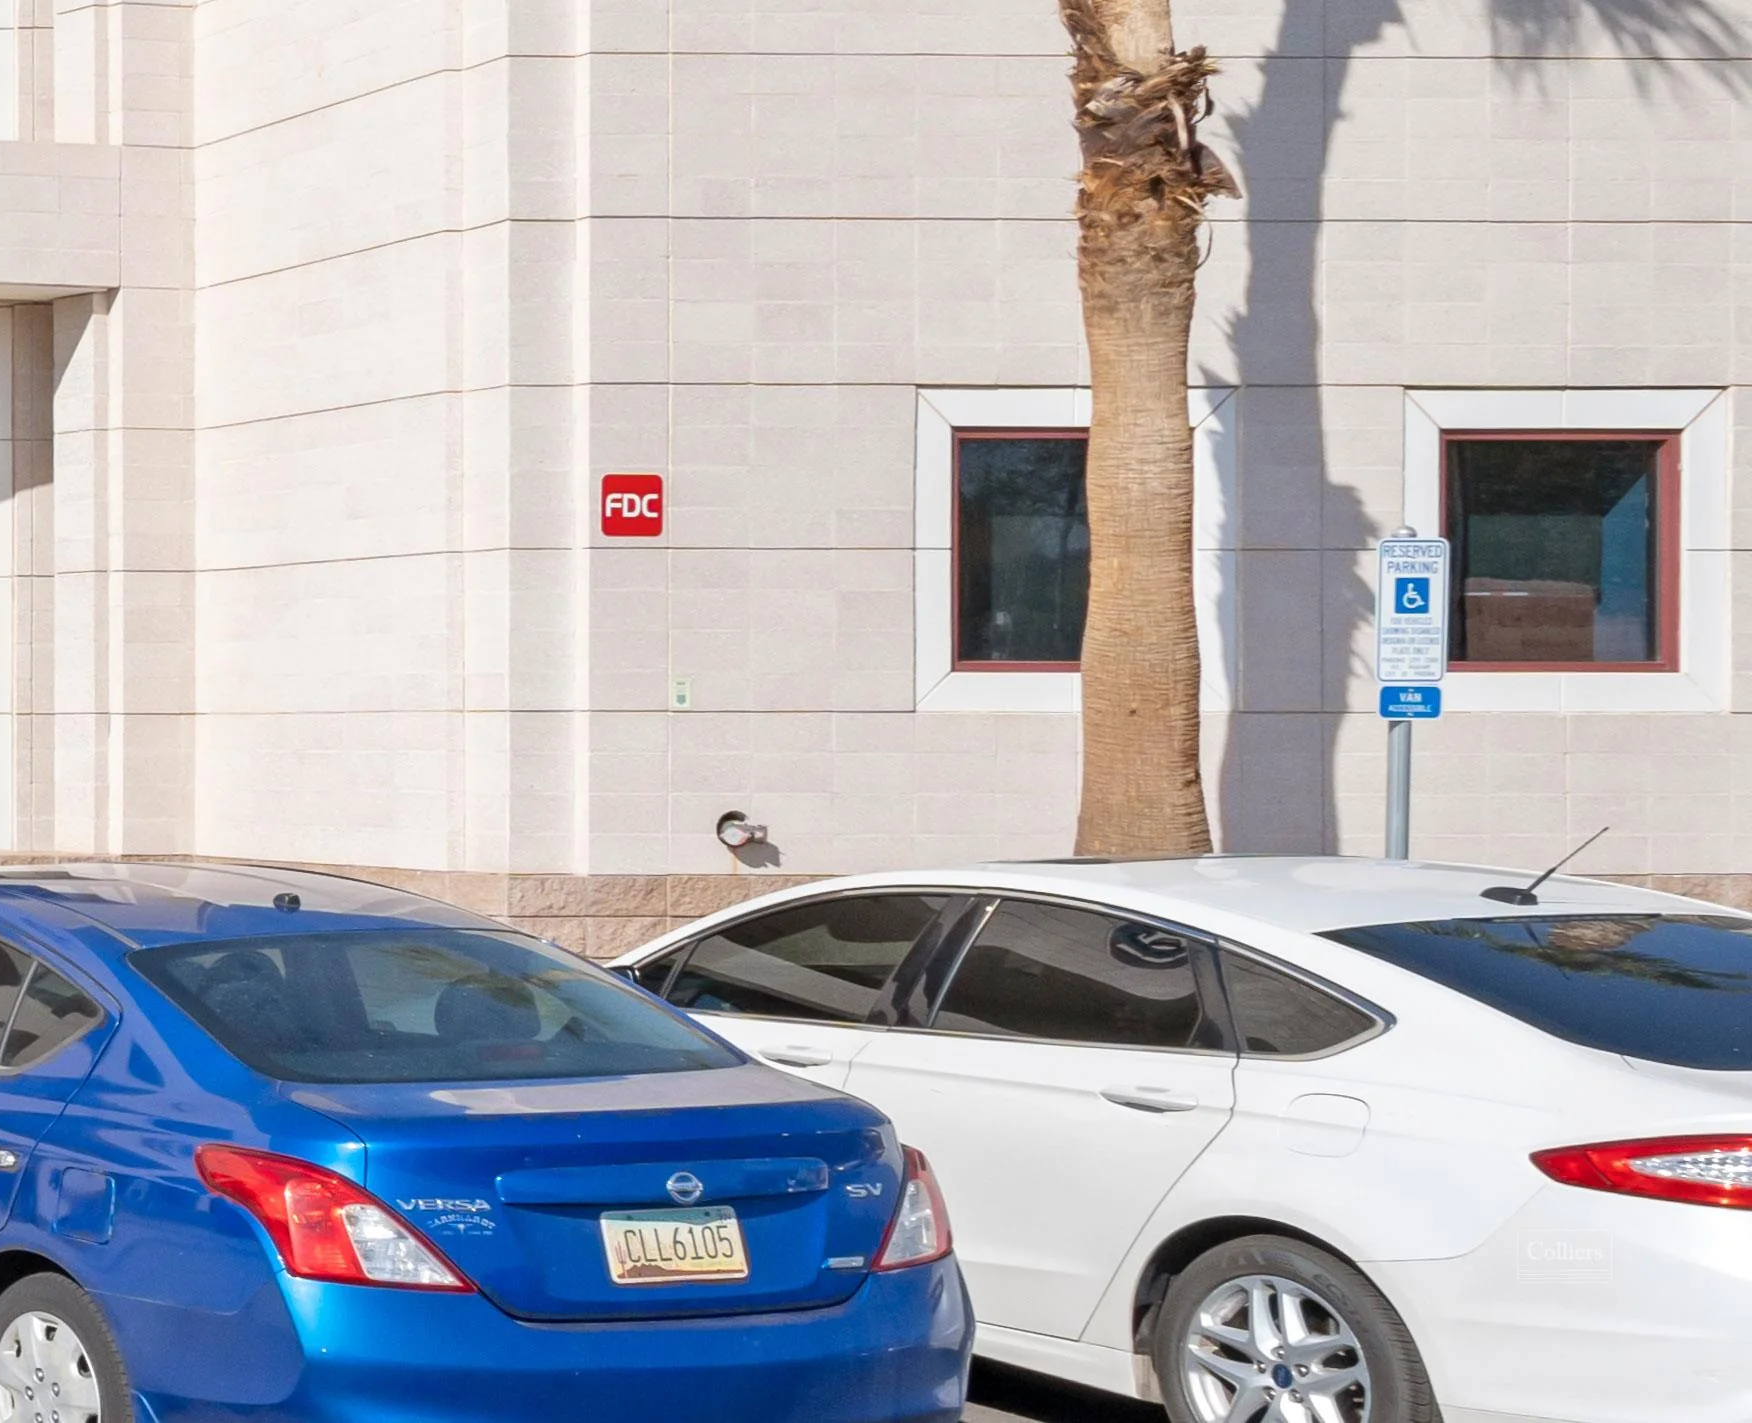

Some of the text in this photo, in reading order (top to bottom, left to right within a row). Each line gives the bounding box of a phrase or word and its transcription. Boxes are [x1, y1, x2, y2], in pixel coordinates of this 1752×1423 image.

[605, 492, 659, 518] FDC
[1382, 544, 1442, 559] RESERVED
[1387, 561, 1438, 574] PARKING
[1399, 692, 1422, 703] VAN
[845, 1183, 883, 1197] SV
[395, 1198, 492, 1212] VERSA
[624, 1225, 734, 1263] CLL6105
